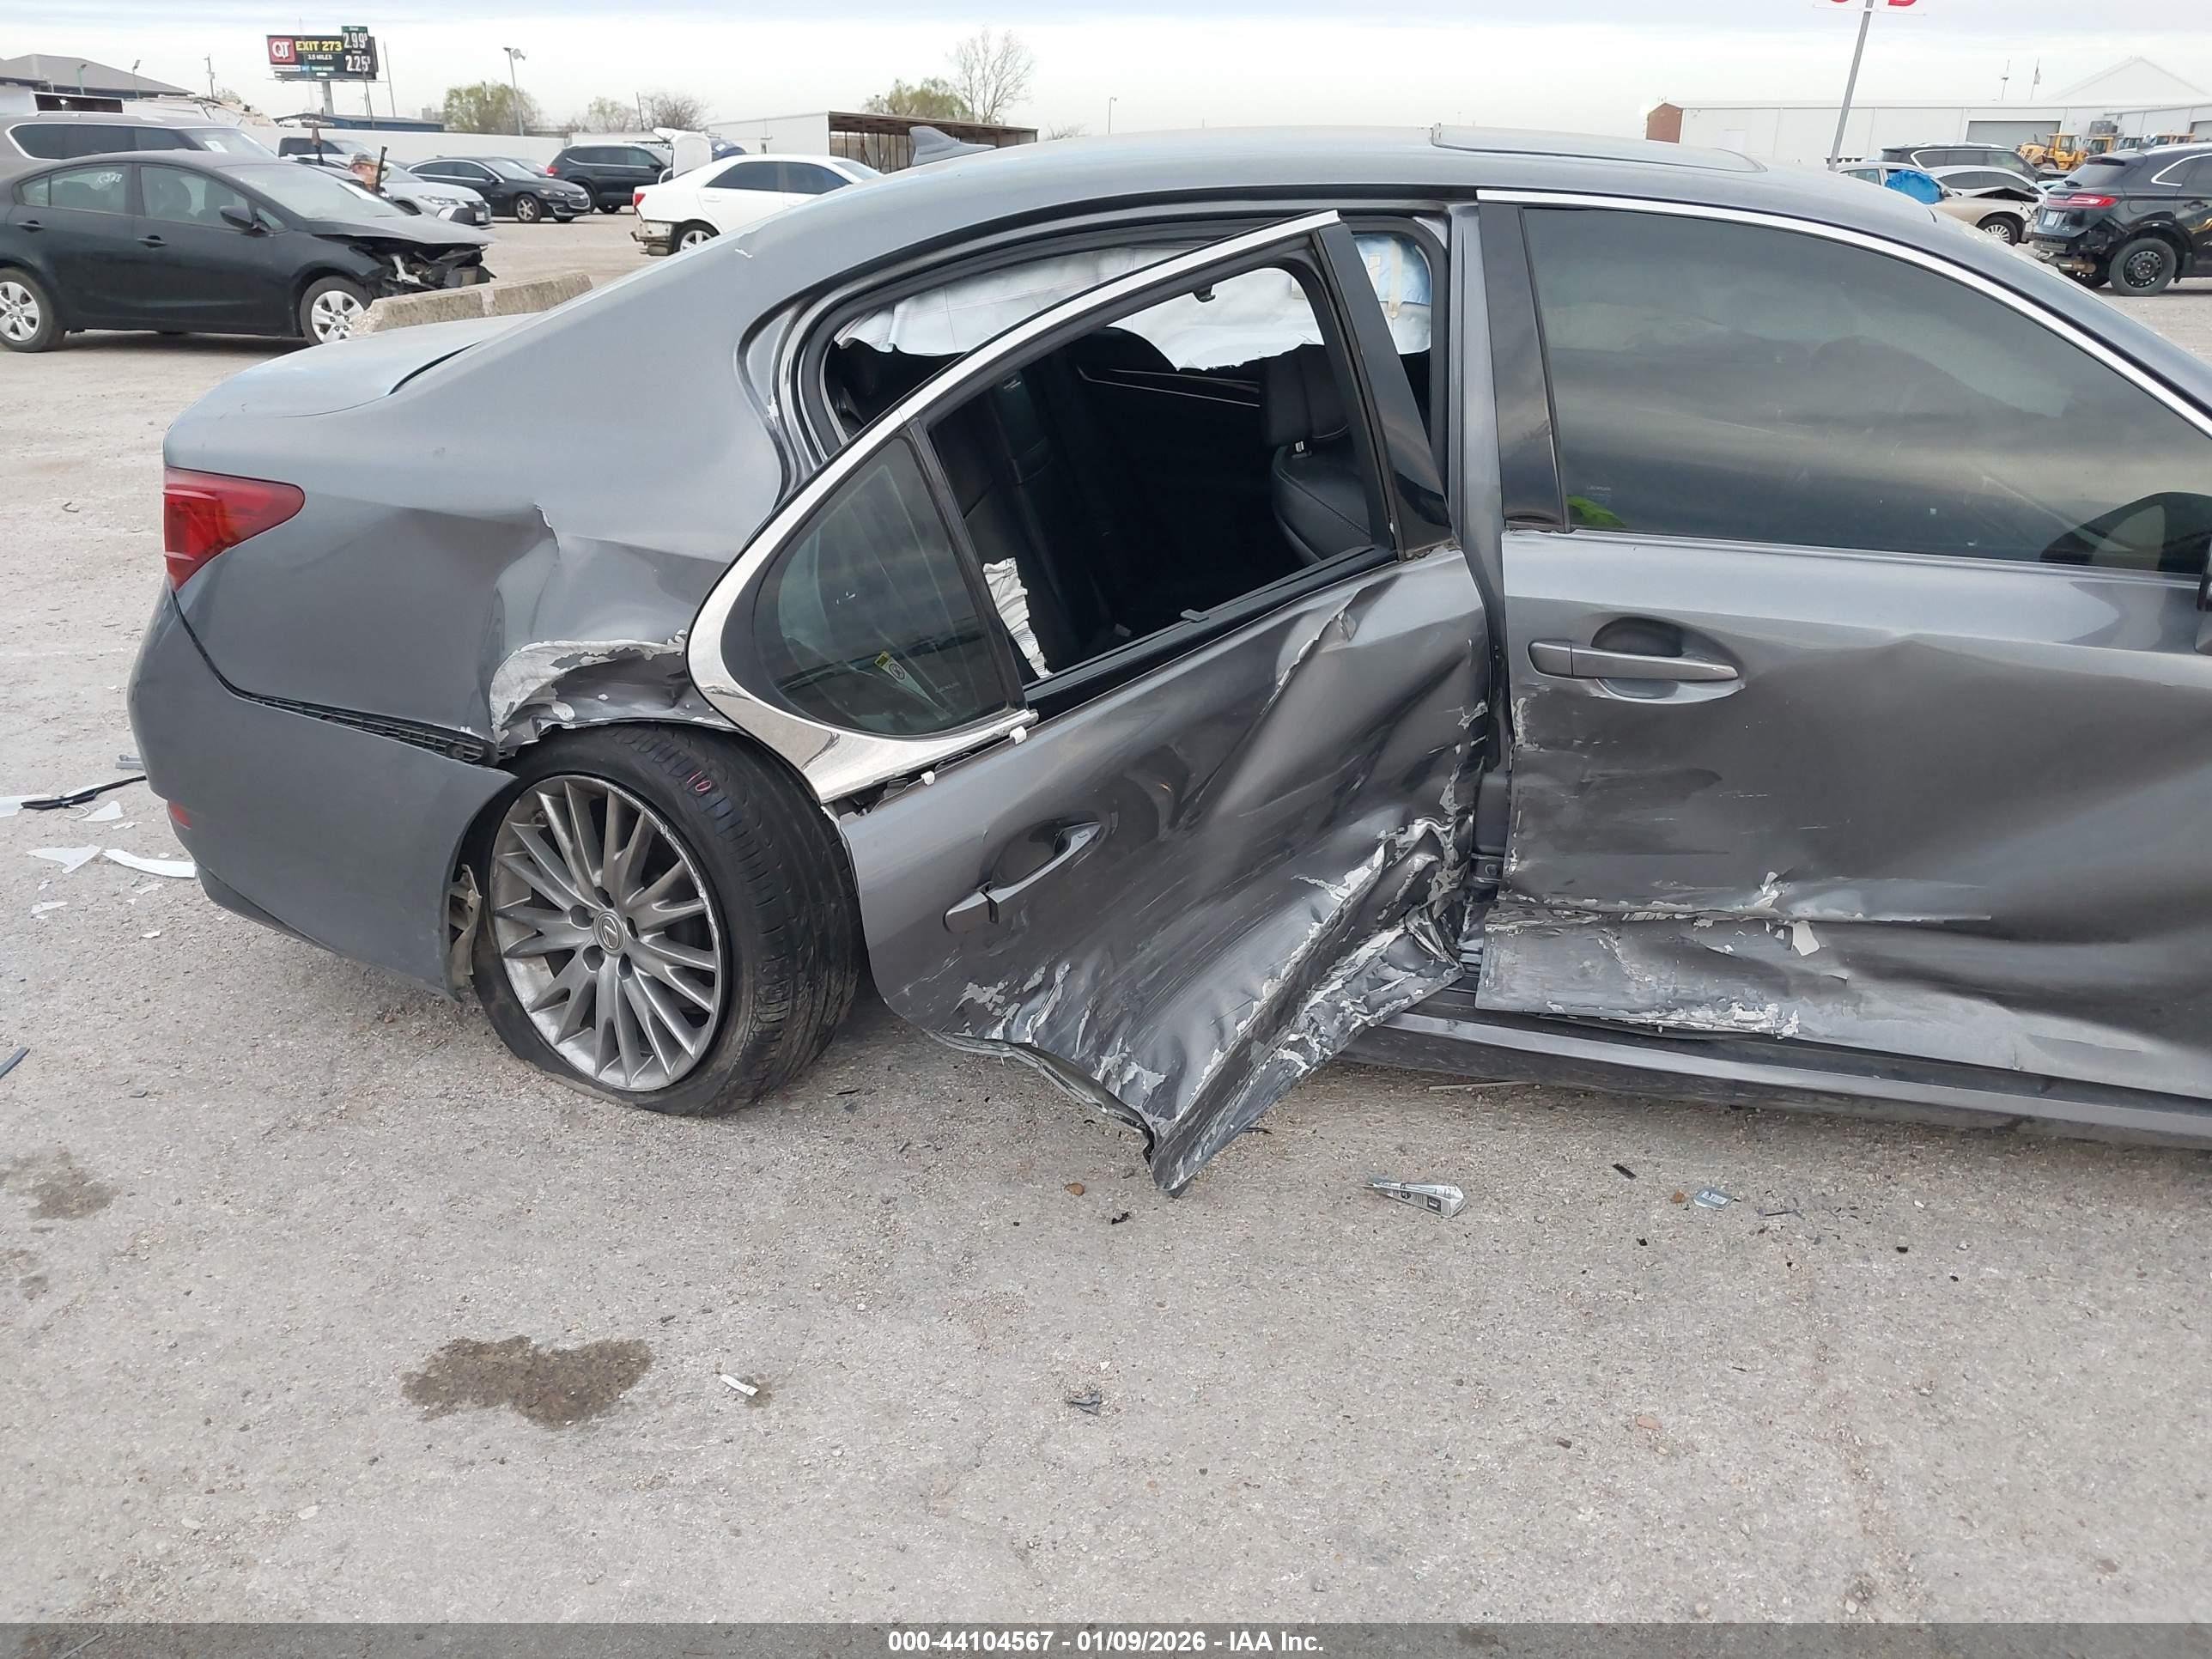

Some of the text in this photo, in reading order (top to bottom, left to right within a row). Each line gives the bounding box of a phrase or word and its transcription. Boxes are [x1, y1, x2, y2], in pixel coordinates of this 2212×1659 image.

[271, 40, 289, 59] QT
[295, 40, 319, 52] EXIT
[322, 40, 342, 52] 273
